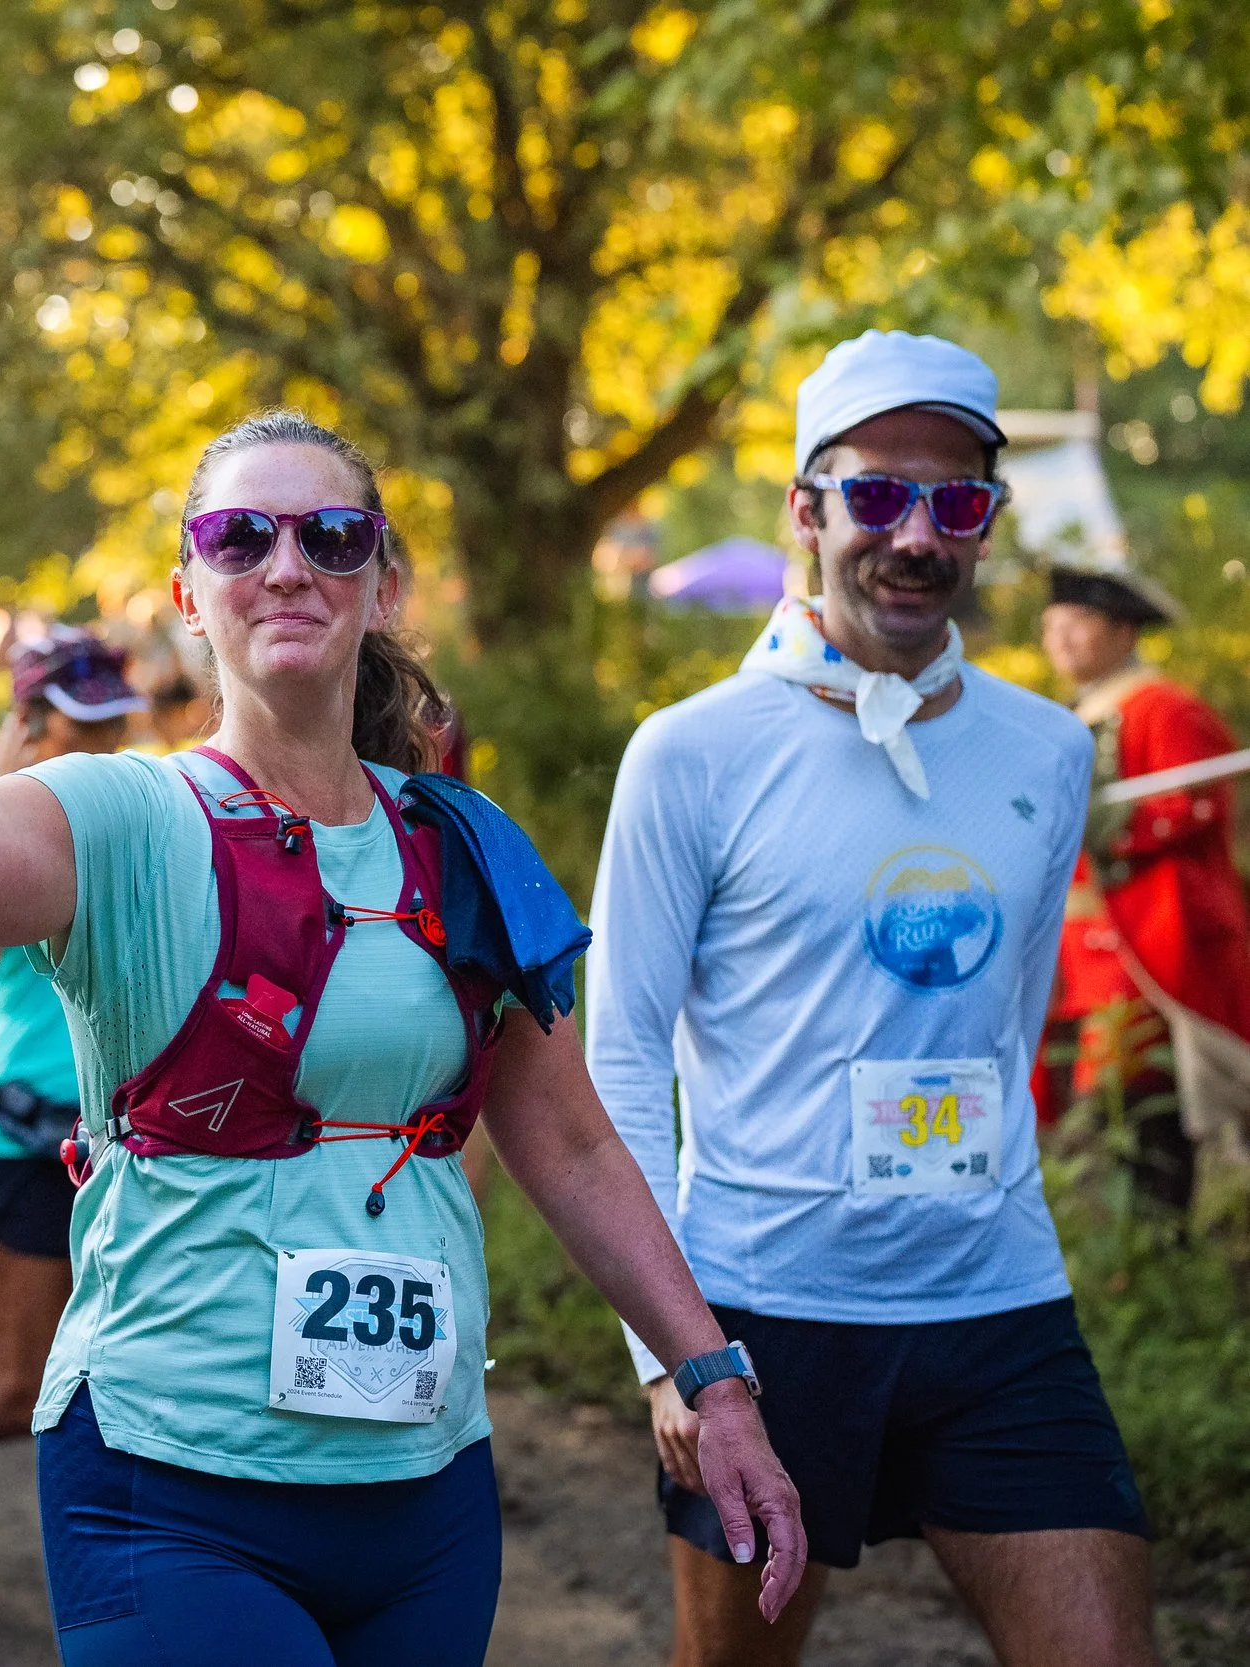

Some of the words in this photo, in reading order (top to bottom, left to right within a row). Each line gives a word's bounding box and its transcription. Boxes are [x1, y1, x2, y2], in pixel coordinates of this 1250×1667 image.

[237, 1014, 270, 1038] ALL-NATURAL
[241, 1011, 272, 1031] LONG-LASTING
[899, 1093, 963, 1148] 34
[302, 1269, 436, 1351] 235
[301, 1389, 316, 1397] Event
[317, 1391, 343, 1399] Schedule
